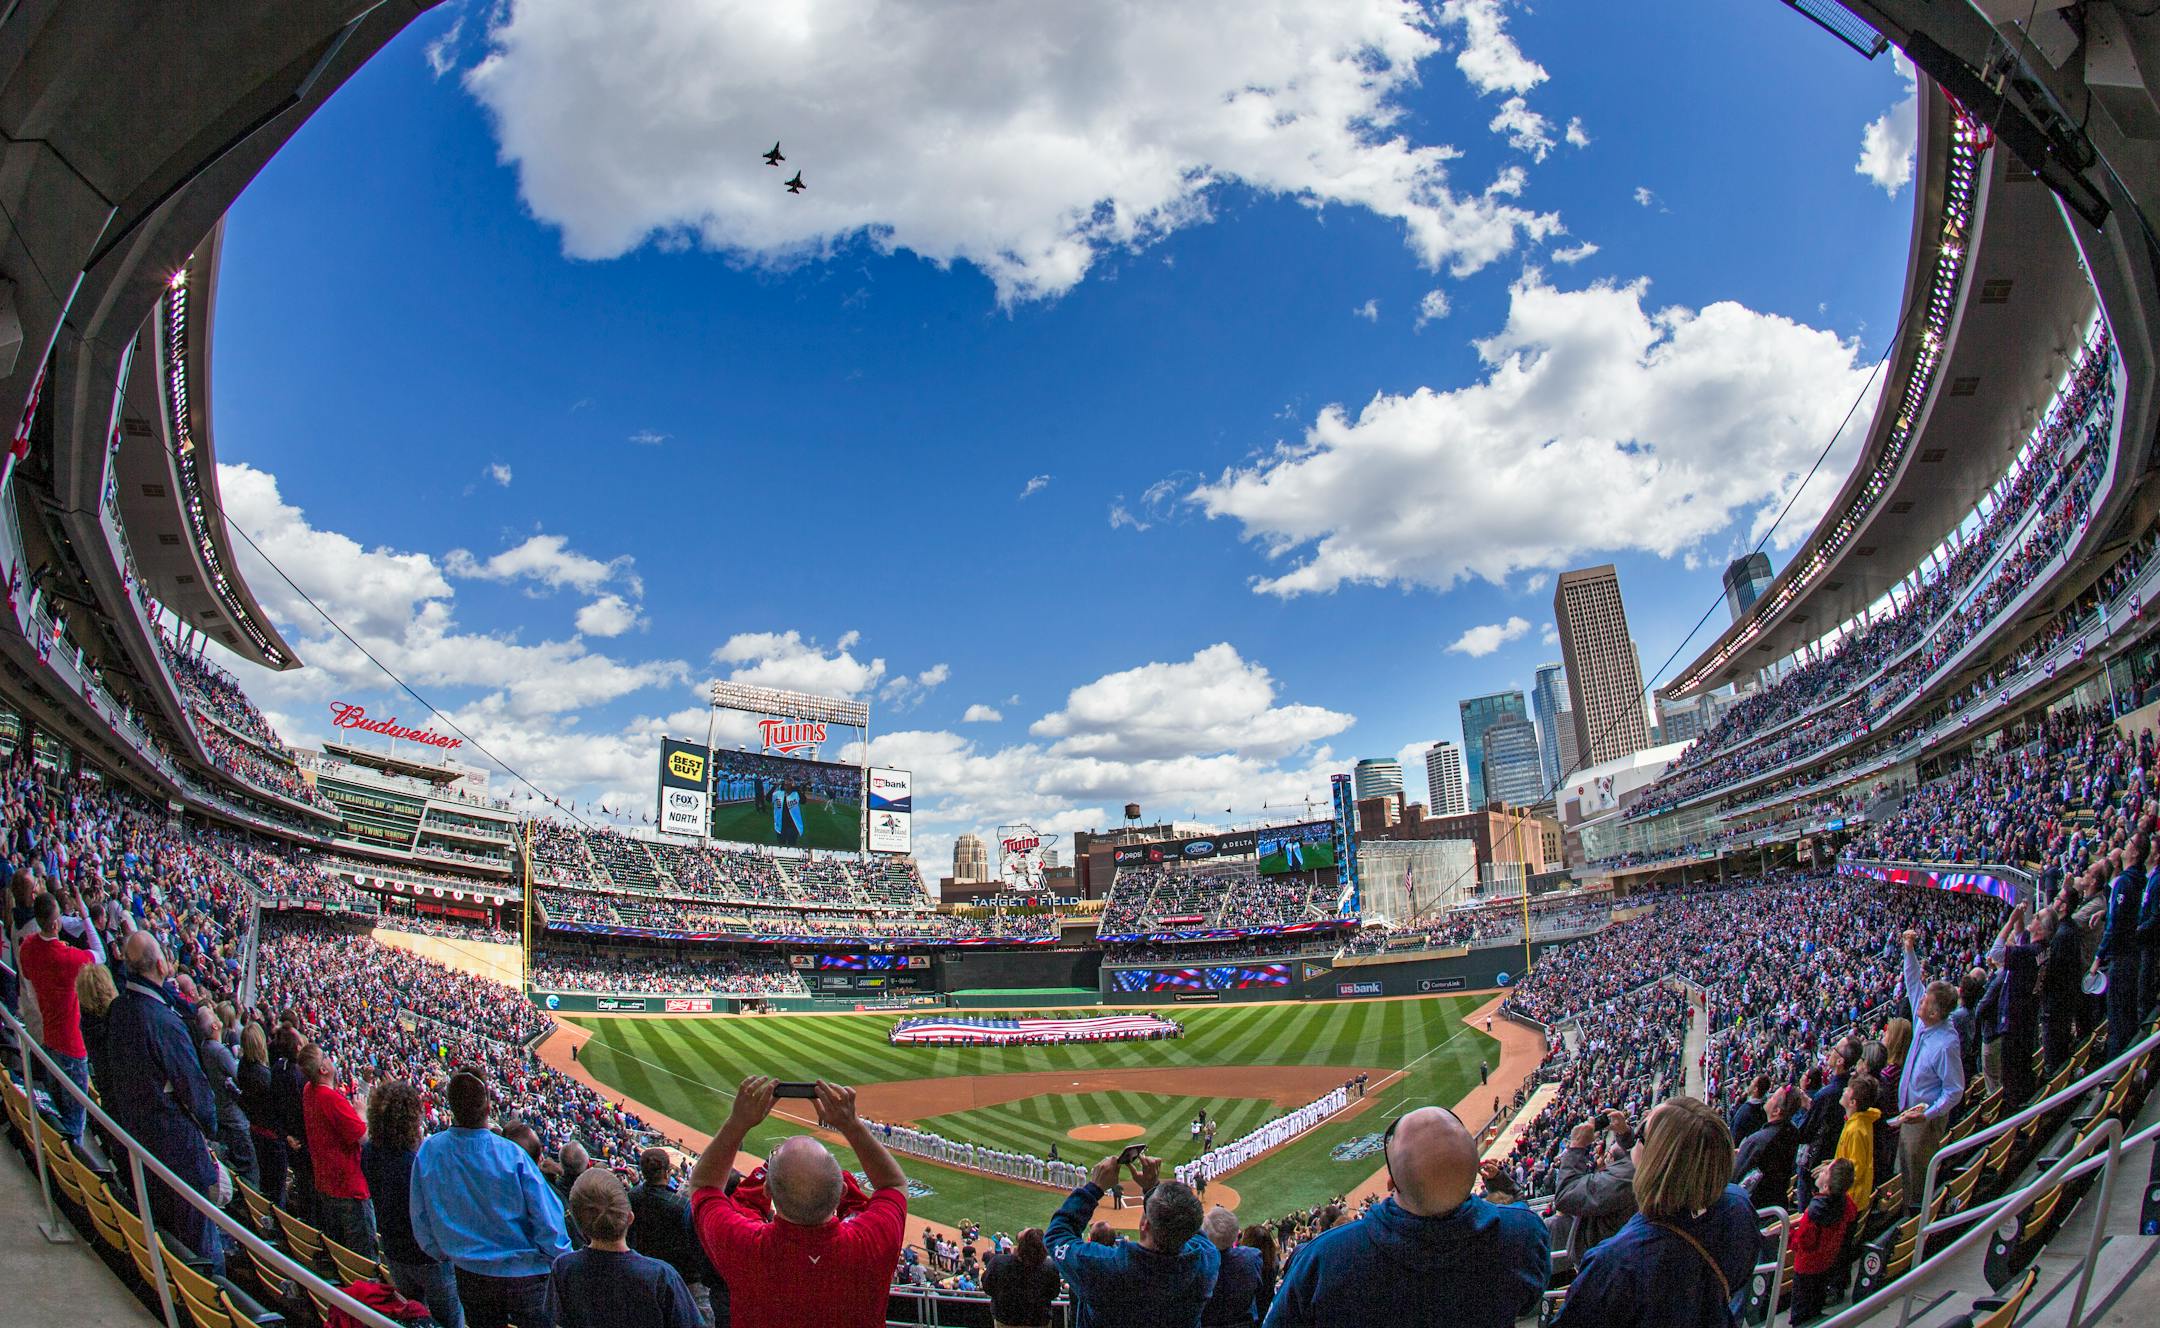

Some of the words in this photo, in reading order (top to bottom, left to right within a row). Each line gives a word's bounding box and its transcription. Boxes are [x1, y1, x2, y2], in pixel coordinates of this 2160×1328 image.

[330, 701, 463, 749] Budweiser
[758, 716, 827, 752] Twins
[673, 755, 702, 769] BEST
[673, 763, 699, 777] BUY
[675, 794, 693, 805] FOX
[669, 811, 698, 824] NORTH
[364, 825, 384, 837] TWINS
[1002, 836, 1040, 854] Twins
[1190, 844, 1208, 853] Ford
[1229, 839, 1253, 848] DELTA
[1124, 850, 1142, 860] pepsi
[970, 898, 1026, 907] TARGET
[1040, 896, 1080, 906] FIELD
[1431, 980, 1460, 988] CenturyLink
[600, 1001, 619, 1011] Cargill
